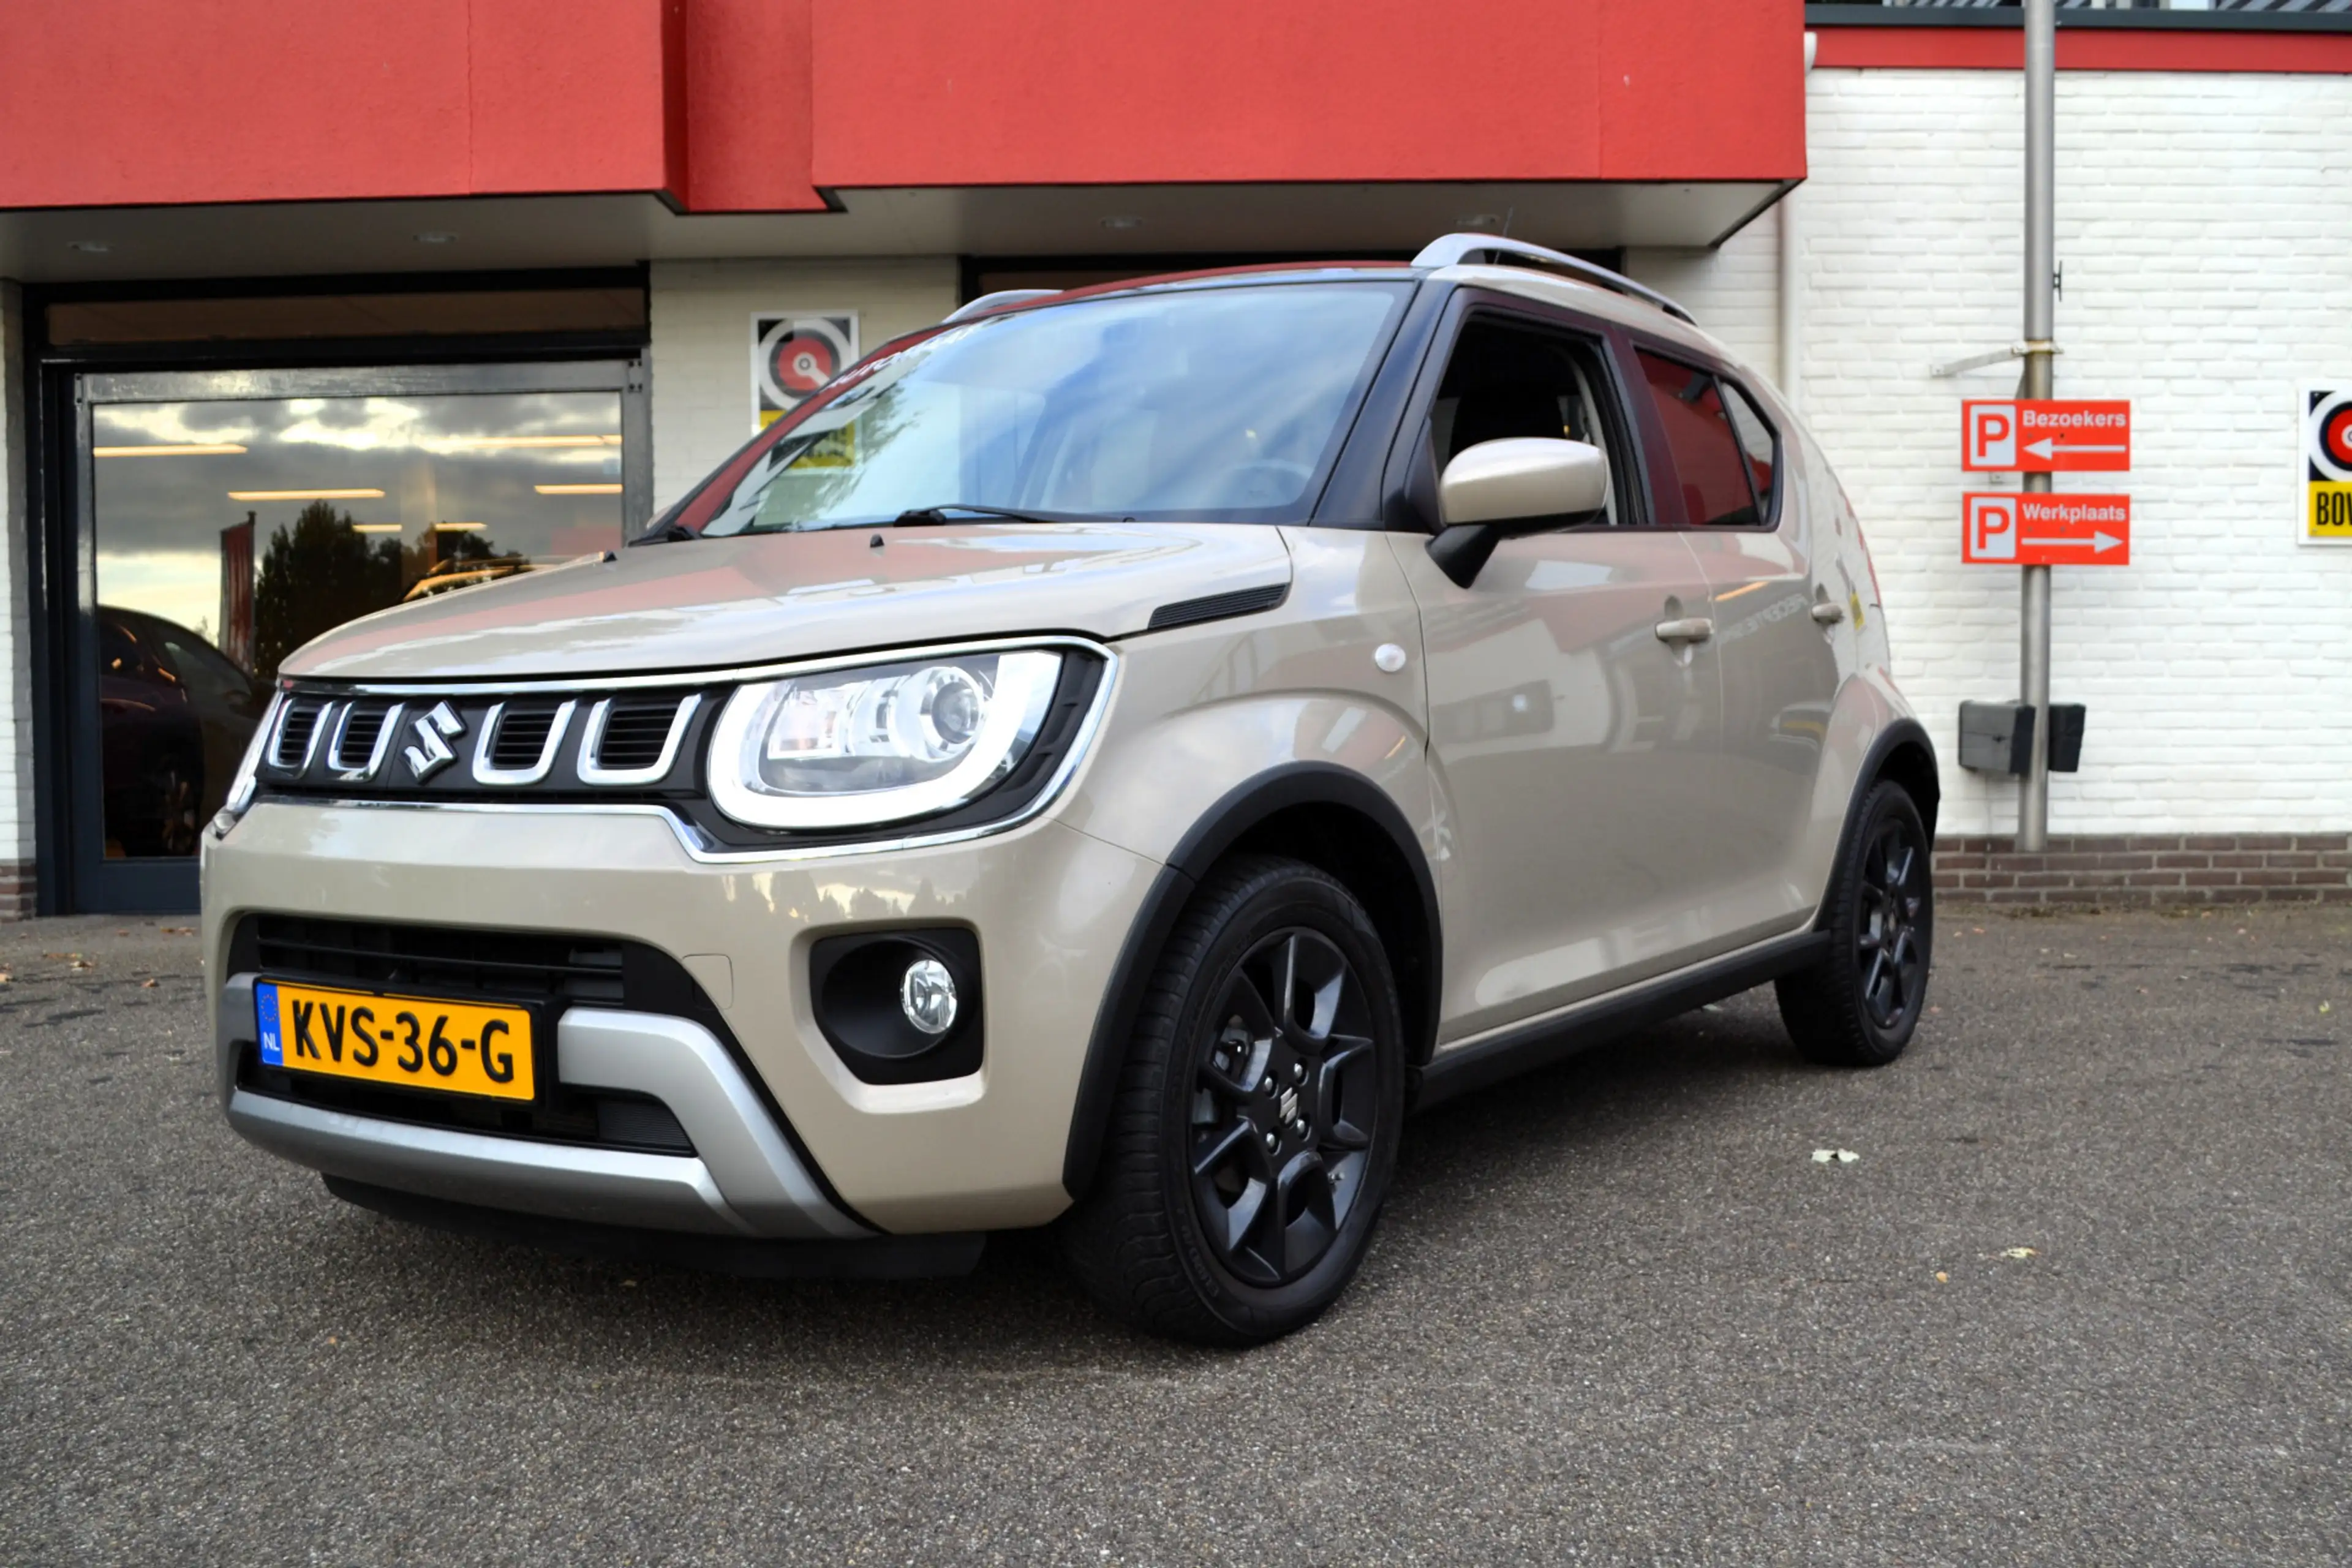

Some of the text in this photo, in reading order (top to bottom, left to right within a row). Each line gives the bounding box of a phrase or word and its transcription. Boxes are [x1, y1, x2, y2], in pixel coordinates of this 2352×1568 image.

[1977, 410, 2127, 458] P Bezoekers
[1977, 503, 2127, 549] P Werkplaats
[263, 1032, 281, 1052] NL
[292, 999, 514, 1084] KVS-36-G
